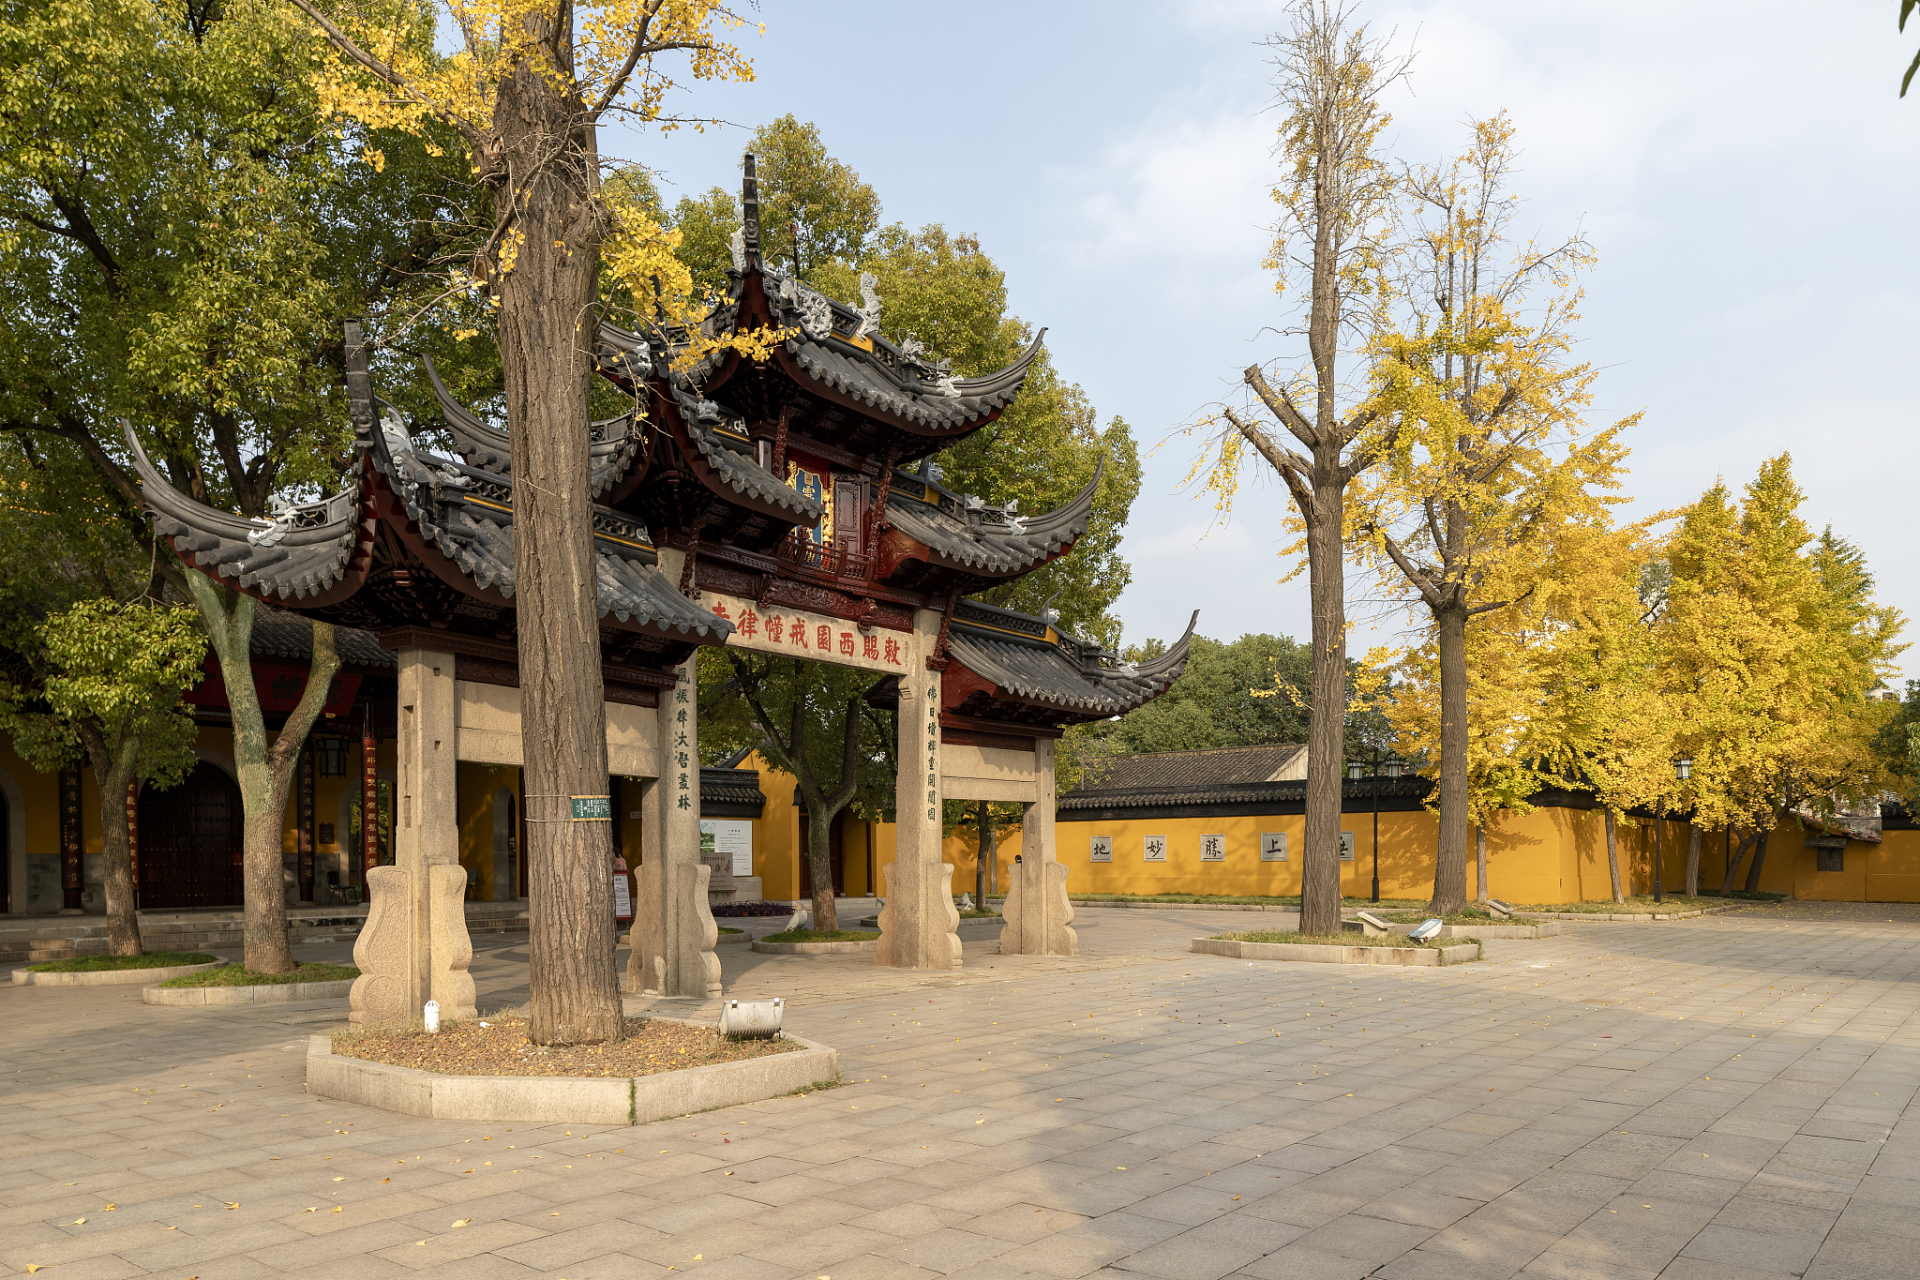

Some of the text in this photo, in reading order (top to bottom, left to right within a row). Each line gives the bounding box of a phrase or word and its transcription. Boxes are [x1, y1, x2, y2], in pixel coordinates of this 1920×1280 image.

[1093, 843, 1110, 855] 地
[1146, 840, 1163, 857] 妙
[1266, 838, 1282, 854] 上
